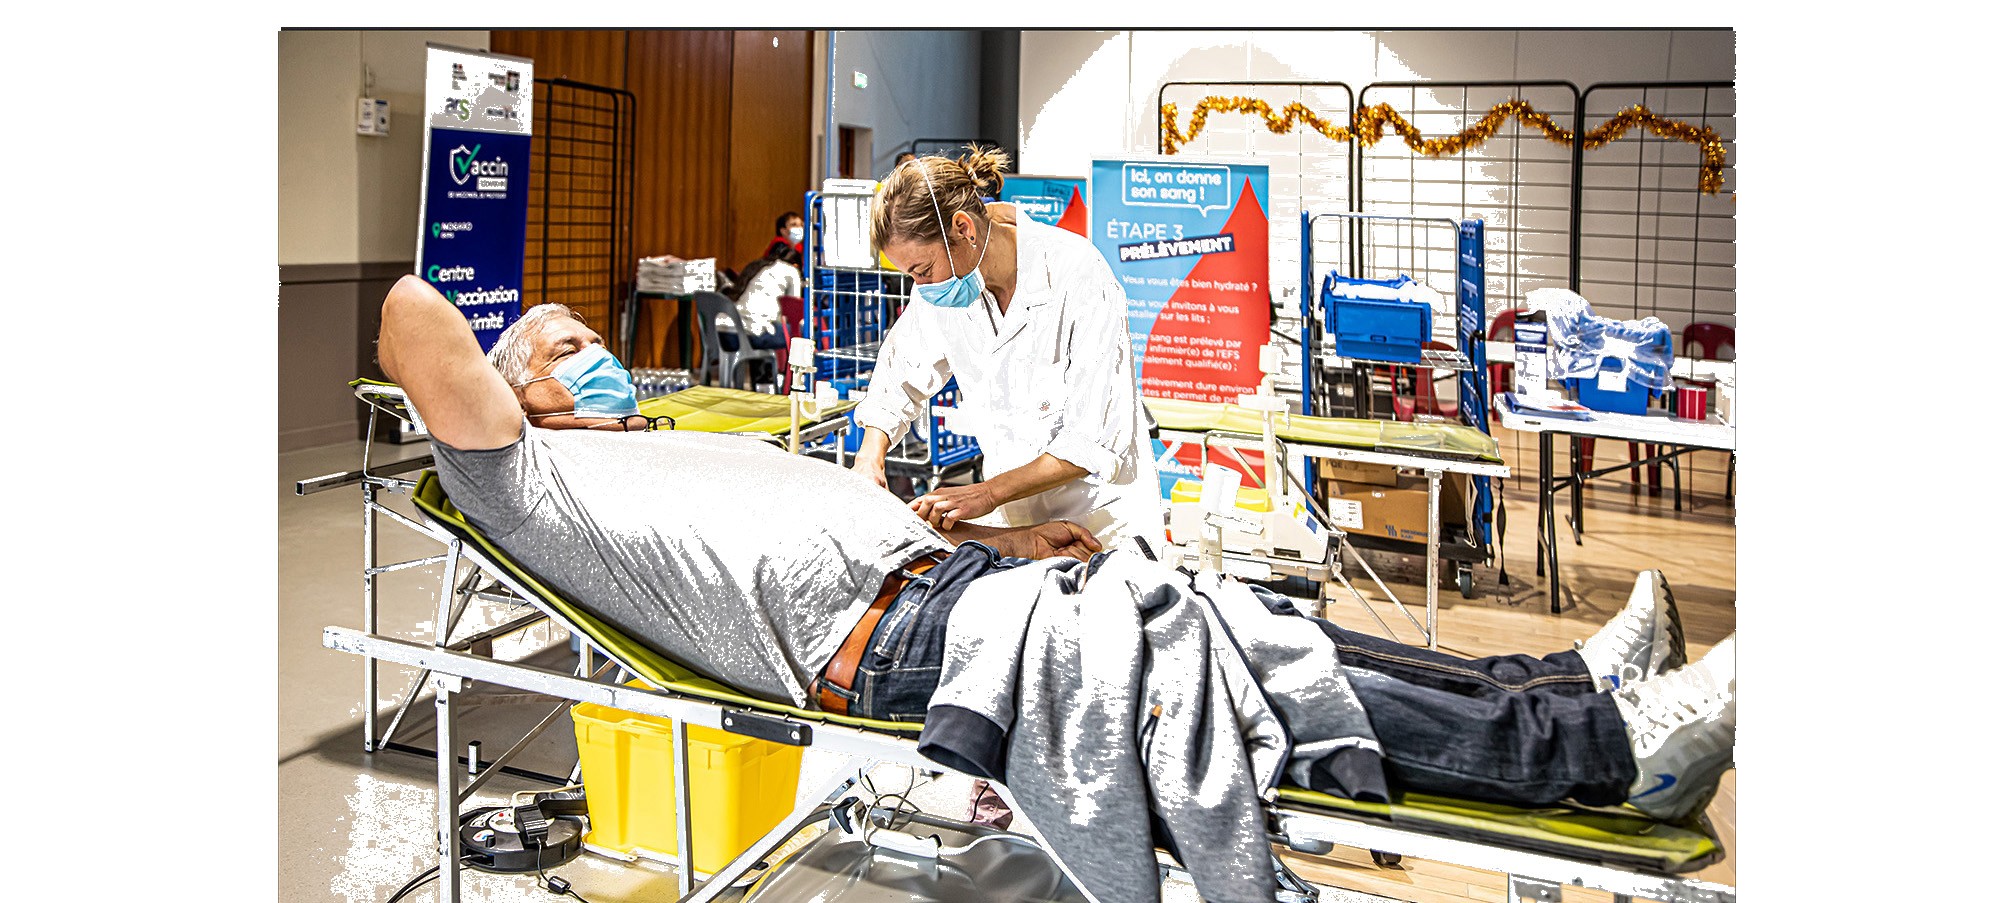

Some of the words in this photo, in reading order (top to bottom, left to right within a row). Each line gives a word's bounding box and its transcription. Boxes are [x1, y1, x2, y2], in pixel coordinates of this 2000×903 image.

[1131, 168, 1151, 184] Ici,
[1155, 171, 1173, 183] on
[1176, 170, 1222, 185] donne
[1131, 186, 1157, 198] son
[1160, 187, 1197, 203] sang
[1200, 186, 1205, 200] !
[1107, 218, 1168, 240] ÉTAPE
[1172, 223, 1184, 240] 3
[1120, 236, 1232, 261] PRÉLÈVEMENT
[427, 264, 475, 282] Centre
[1123, 275, 1145, 285] Vous
[1147, 277, 1168, 286] vous
[1170, 276, 1190, 287] êtes
[1191, 279, 1212, 289] bien
[1214, 280, 1250, 292] hydraté
[446, 285, 519, 306] Vaccination
[1149, 300, 1169, 309] vous
[1171, 300, 1207, 312] invitons
[1209, 302, 1215, 312] à
[1217, 306, 1239, 314] vous
[1160, 312, 1174, 320] sur
[1176, 312, 1189, 321] les
[1191, 313, 1205, 323] lits
[1150, 334, 1171, 343] sang
[1173, 335, 1188, 344] est
[1190, 336, 1224, 347] prélevé
[1226, 339, 1242, 348] par
[1202, 348, 1215, 357] de
[1185, 359, 1232, 371] qualifié(e)
[1195, 381, 1217, 391] dure
[1219, 384, 1255, 394] environ
[1162, 389, 1171, 398] et
[1173, 391, 1207, 401] permet
[1209, 393, 1221, 402] de
